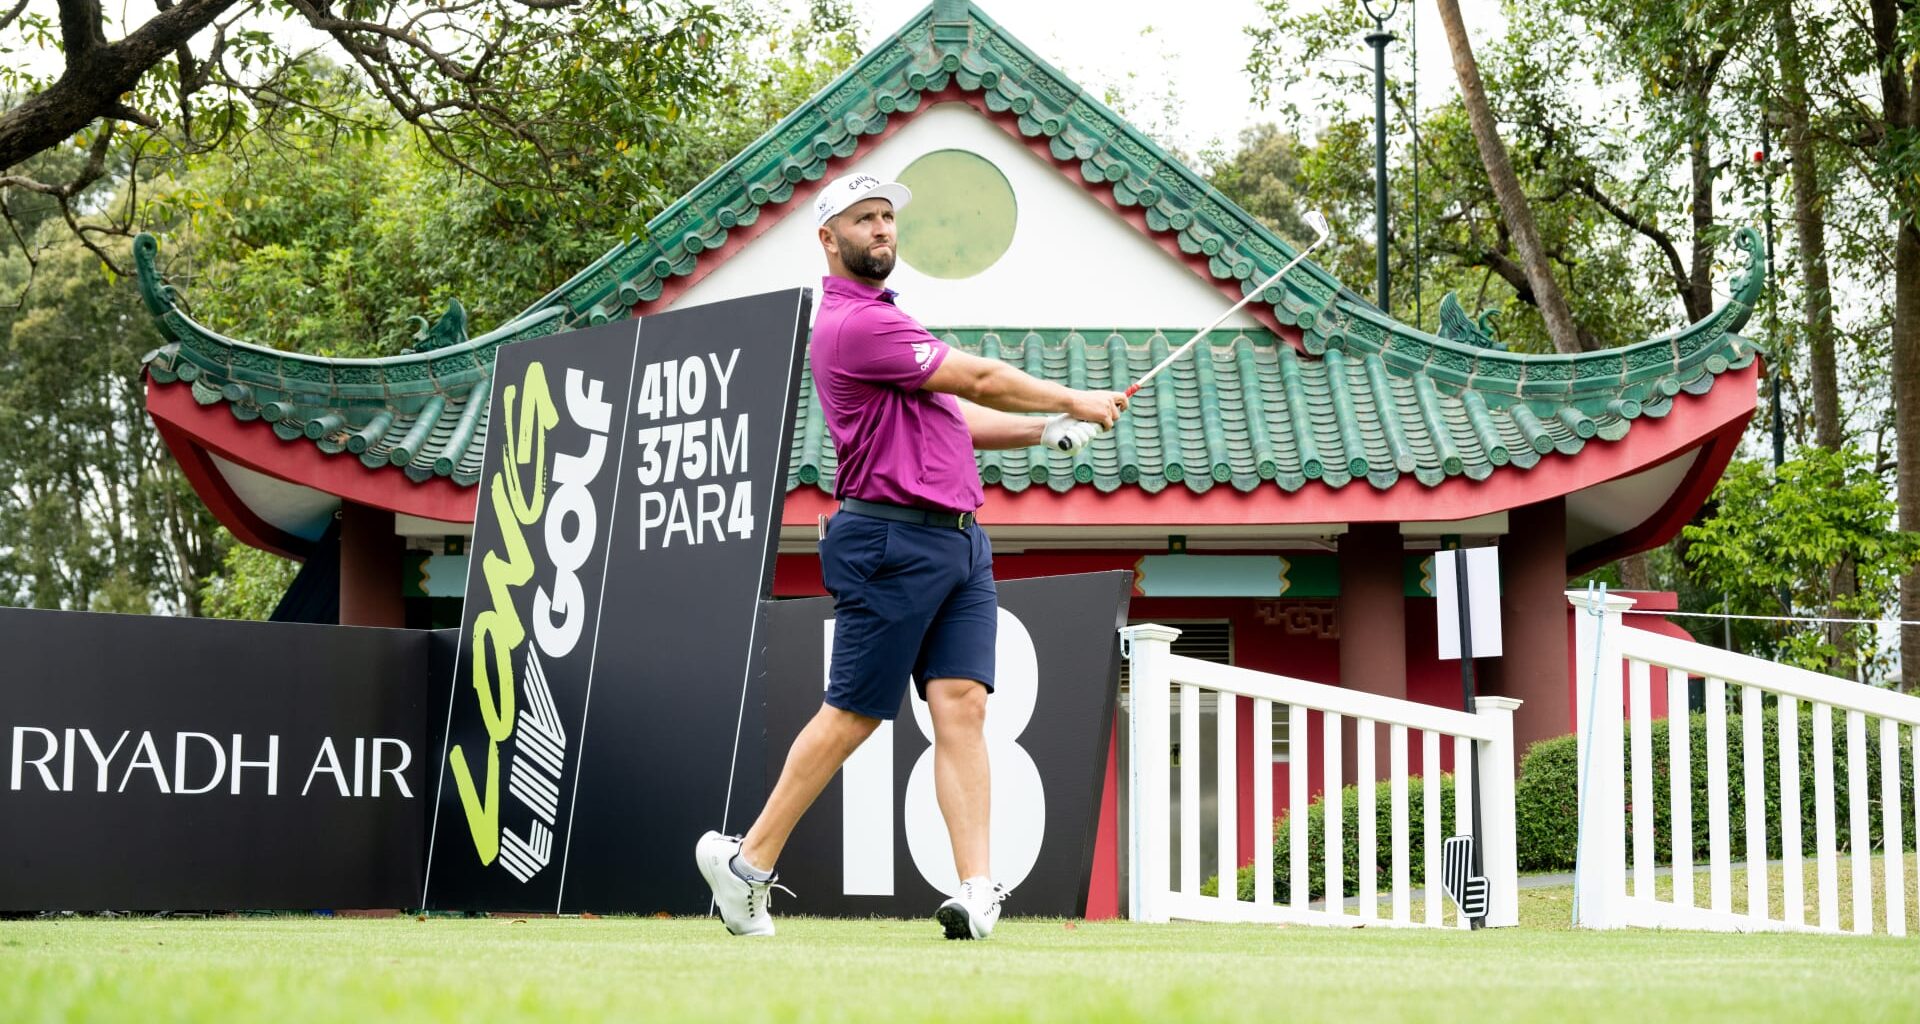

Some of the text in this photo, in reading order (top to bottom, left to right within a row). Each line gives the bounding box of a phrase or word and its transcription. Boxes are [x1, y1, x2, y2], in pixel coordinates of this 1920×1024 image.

[10, 726, 414, 798] RIYADH AIR
[450, 361, 559, 867] LONG
[499, 367, 613, 884] LIV GOLF
[823, 605, 1046, 898] 18
